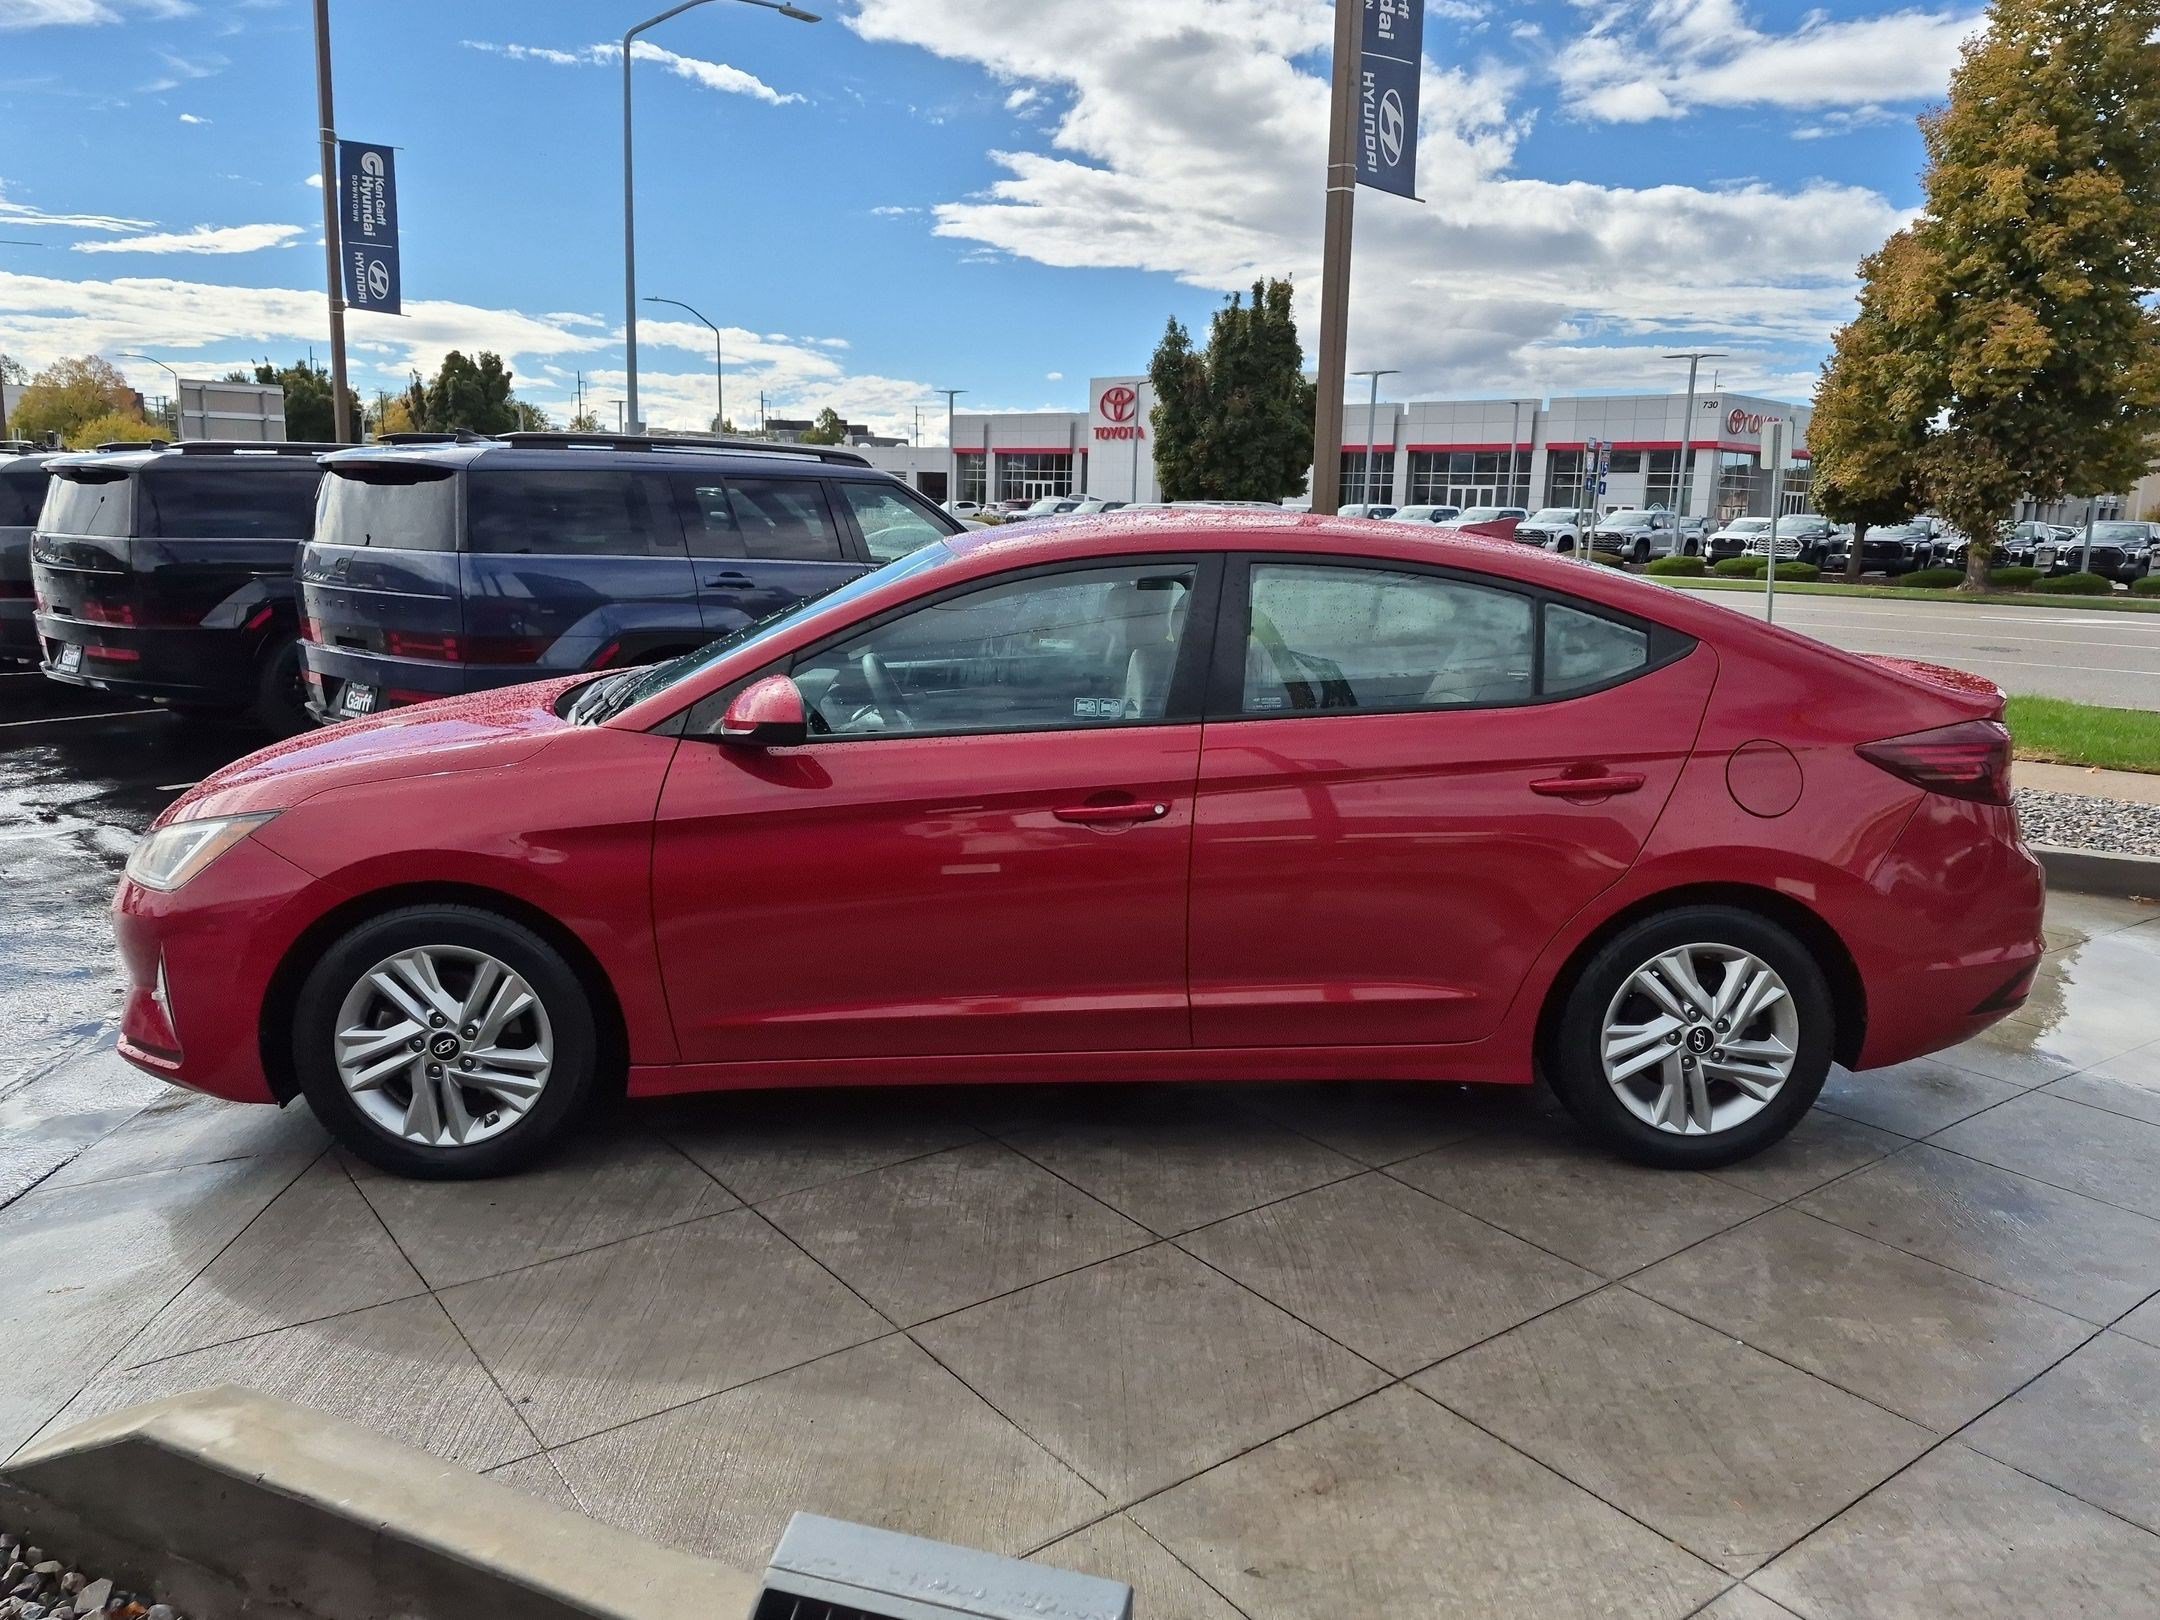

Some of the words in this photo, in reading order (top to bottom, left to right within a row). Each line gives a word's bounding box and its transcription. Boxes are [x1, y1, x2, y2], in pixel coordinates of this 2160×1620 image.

[1362, 71, 1378, 173] HYUNDAI
[351, 174, 359, 222] DOWNTOWN
[374, 177, 385, 198] Ken
[360, 175, 376, 236] Hyundai
[375, 200, 386, 226] Garff
[354, 251, 368, 303] HYUNDAI
[1703, 401, 1718, 409] 730
[1093, 426, 1145, 440] TOYOTA
[346, 690, 373, 712] Garff
